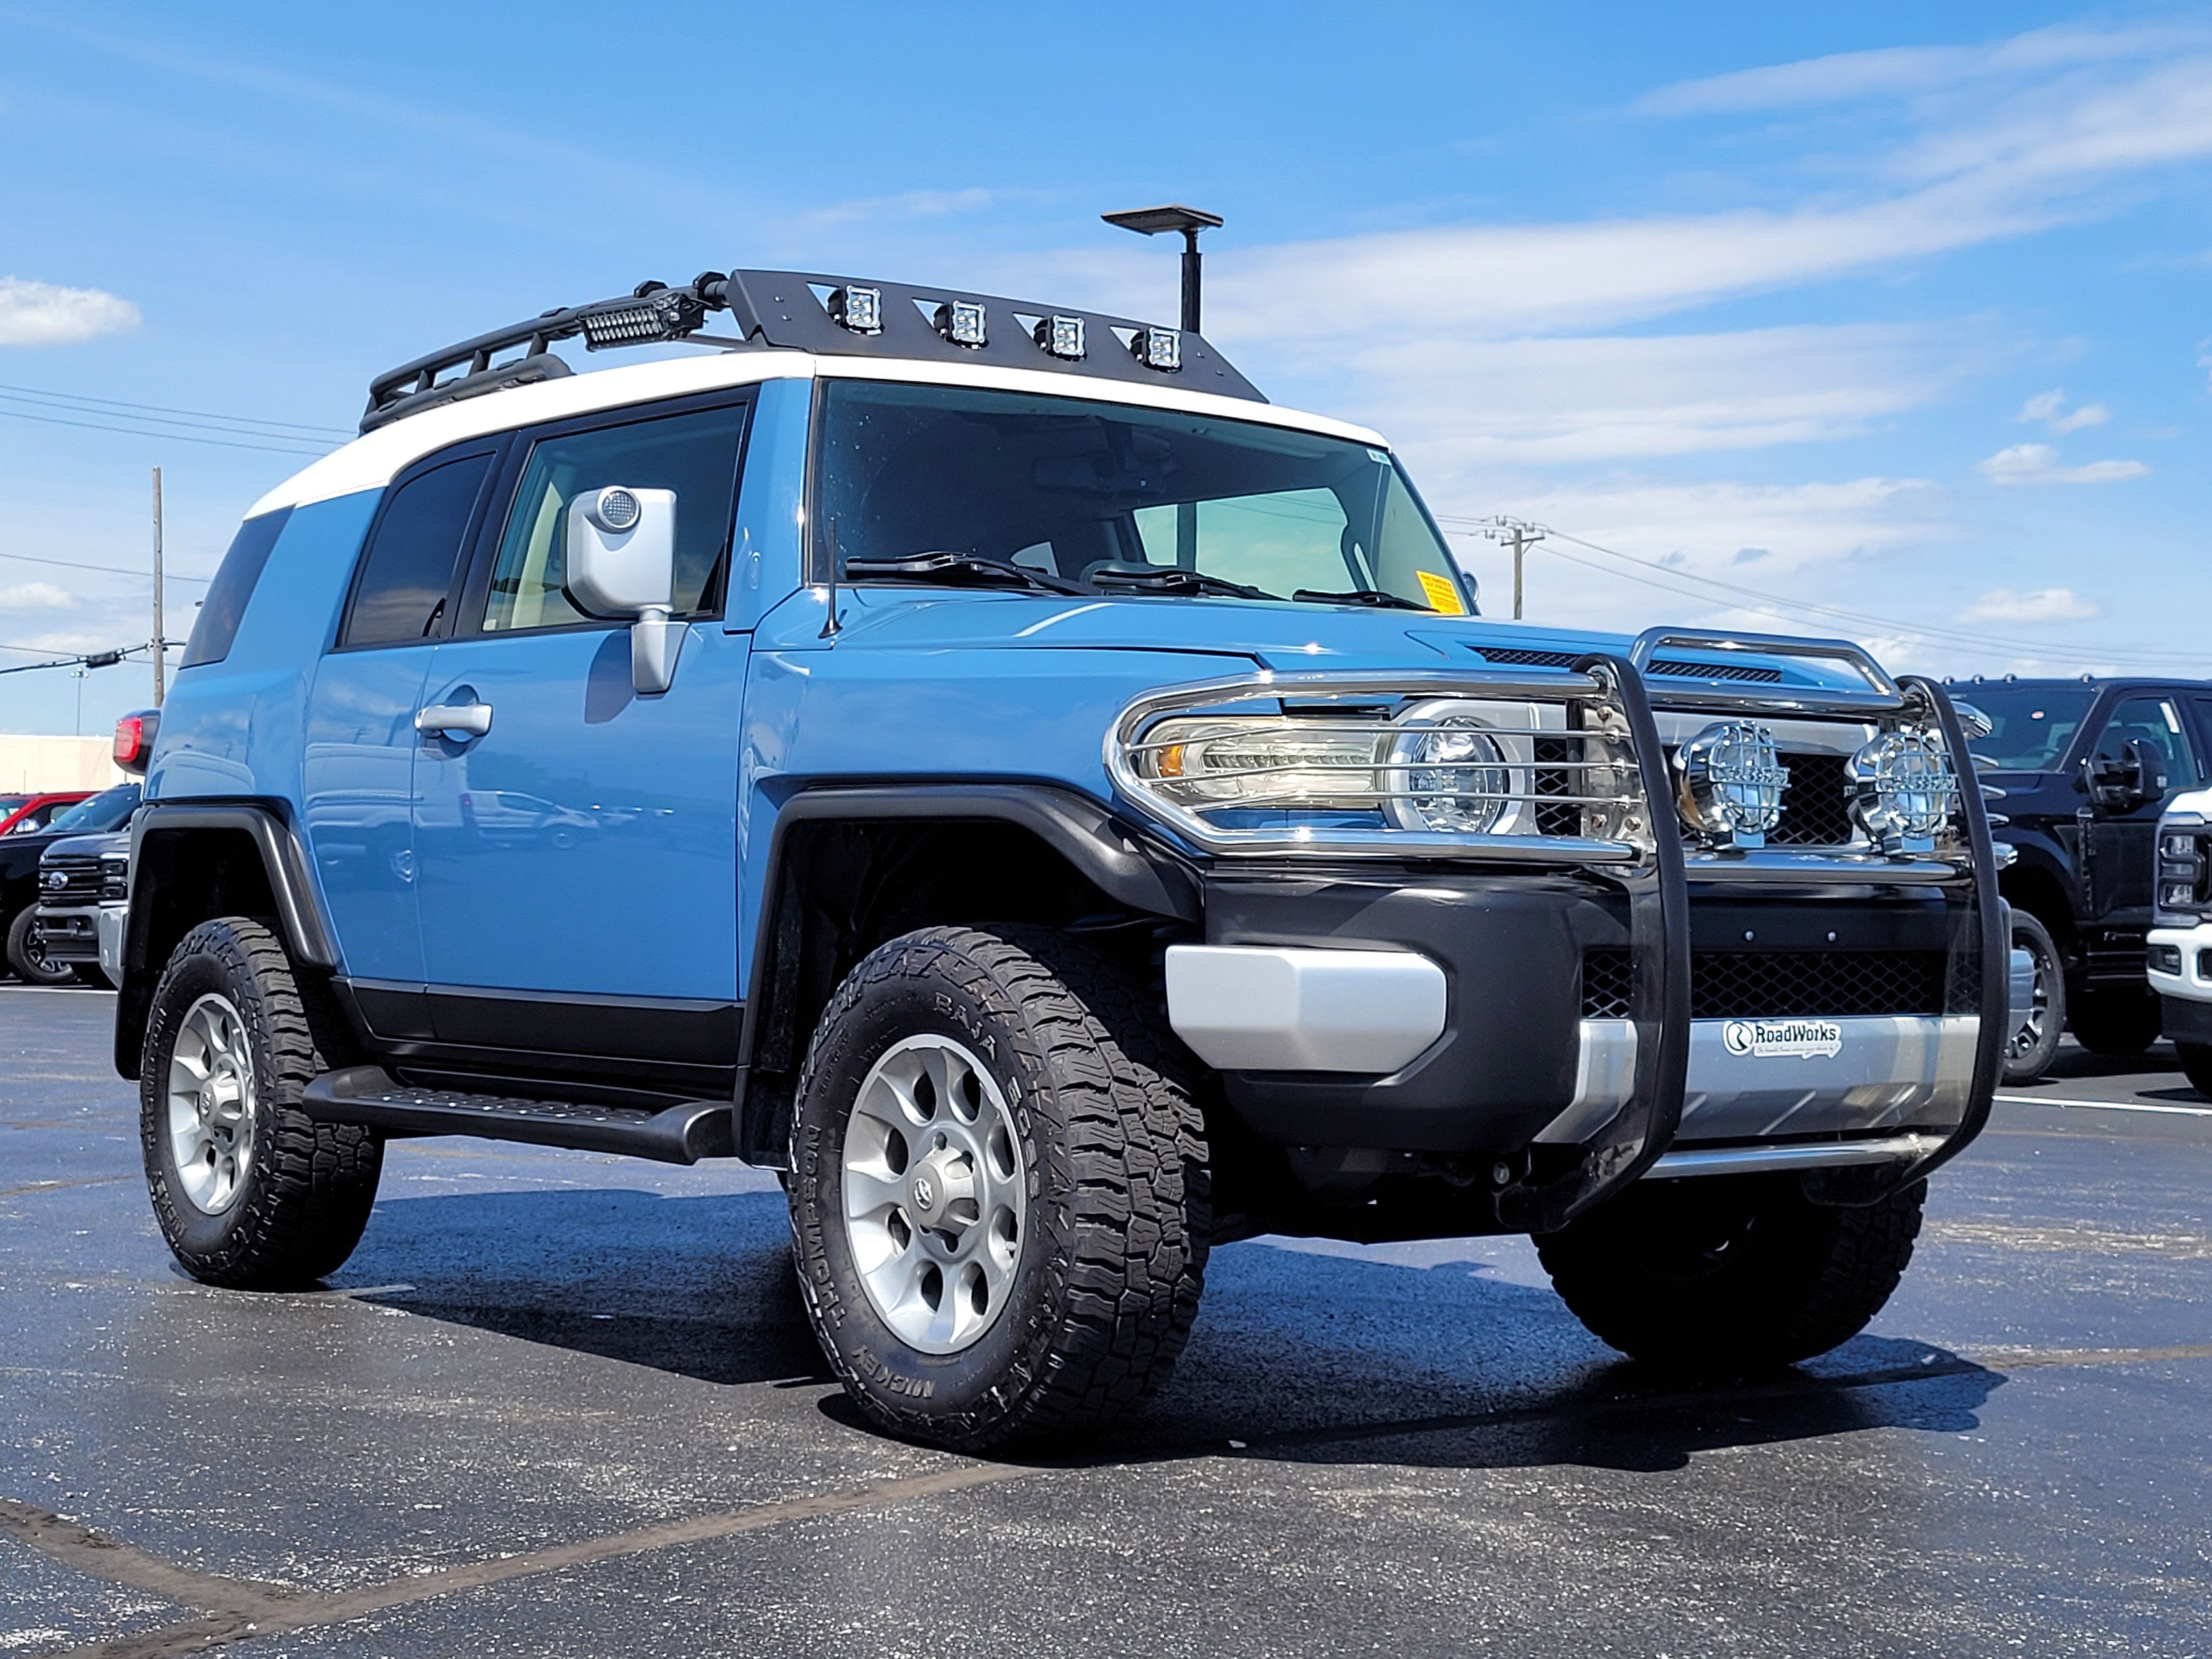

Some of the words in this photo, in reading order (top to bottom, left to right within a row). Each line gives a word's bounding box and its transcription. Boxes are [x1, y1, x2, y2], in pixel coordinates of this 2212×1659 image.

[934, 992, 996, 1061] BAJA
[1008, 1076, 1040, 1200] BOSS
[1755, 1024, 1836, 1043] RoadWorks
[803, 1125, 845, 1328] THOMPSON
[852, 1345, 935, 1398] MICKEY
